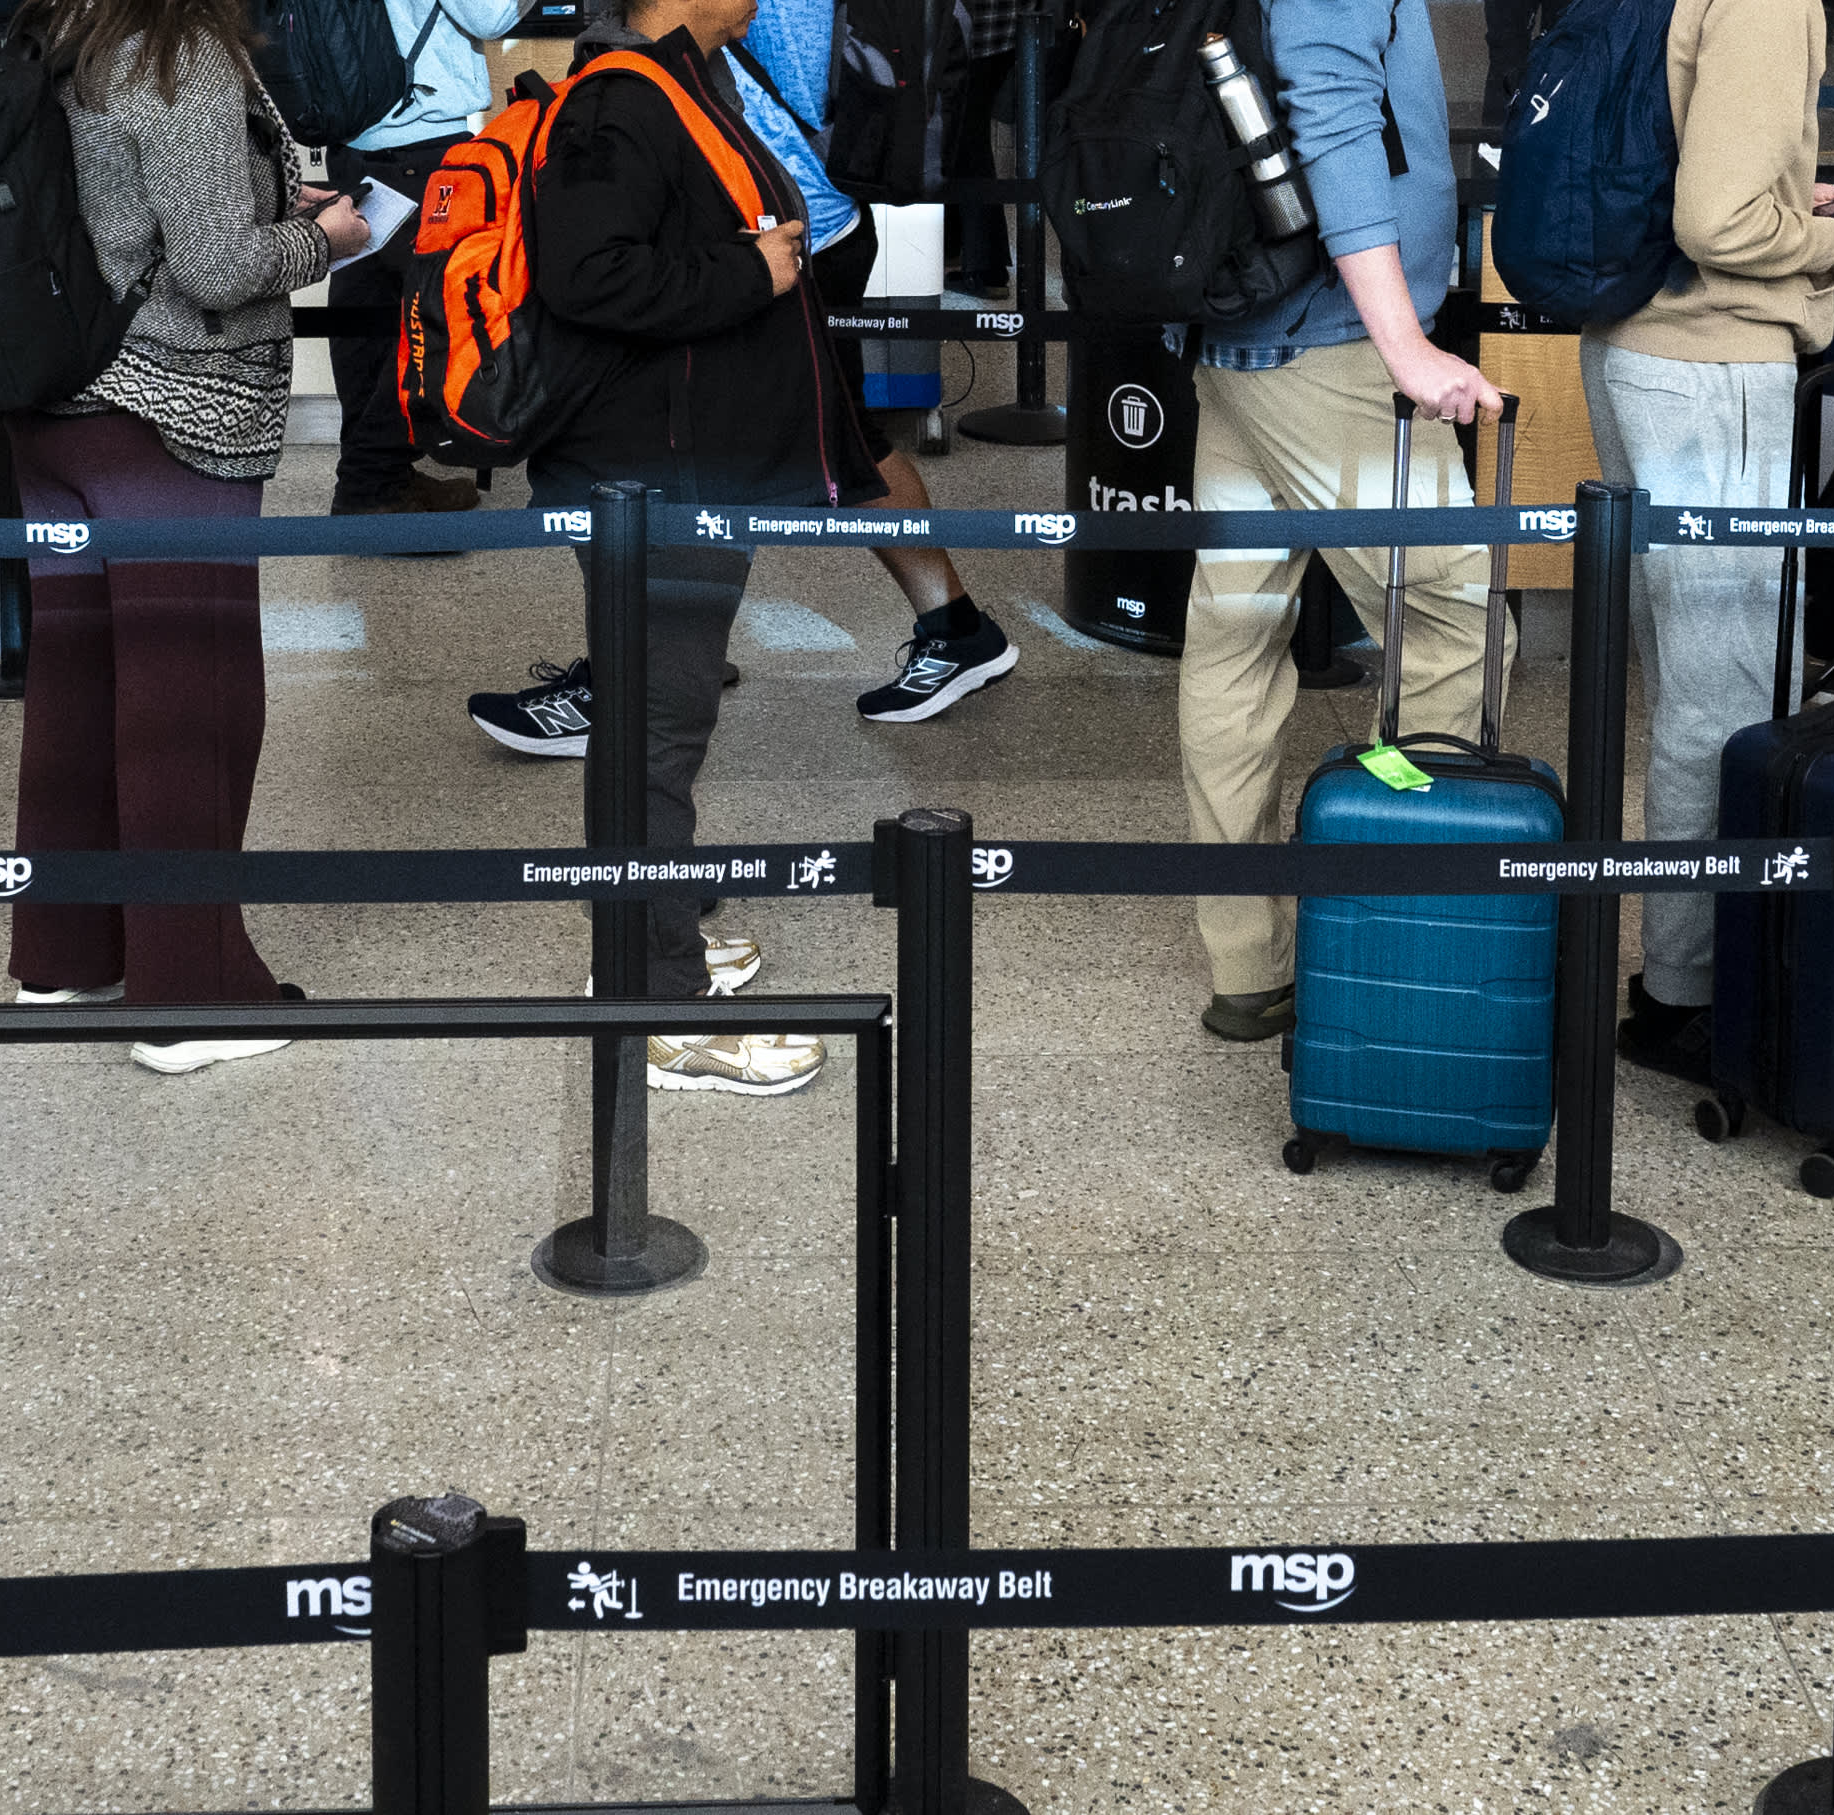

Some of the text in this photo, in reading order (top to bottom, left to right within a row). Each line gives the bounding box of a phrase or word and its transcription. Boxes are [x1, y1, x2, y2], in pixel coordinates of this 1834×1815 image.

[828, 316, 909, 331] Breakaway Belt
[976, 312, 1024, 331] msp
[25, 522, 90, 547] msp
[542, 510, 592, 534] ms
[748, 516, 930, 538] Emergency Breakaway Belt
[1014, 512, 1077, 538] msp
[1729, 517, 1803, 536] Emergency
[1117, 597, 1146, 614] msp
[522, 858, 767, 886] Emergency Breakaway Belt
[972, 847, 1014, 881] sp
[1499, 855, 1741, 882] Emergency Breakaway Belt
[1230, 1551, 1356, 1601] msp
[286, 1574, 373, 1617] ms
[677, 1570, 1054, 1608] Emergency Breakaway Belt
